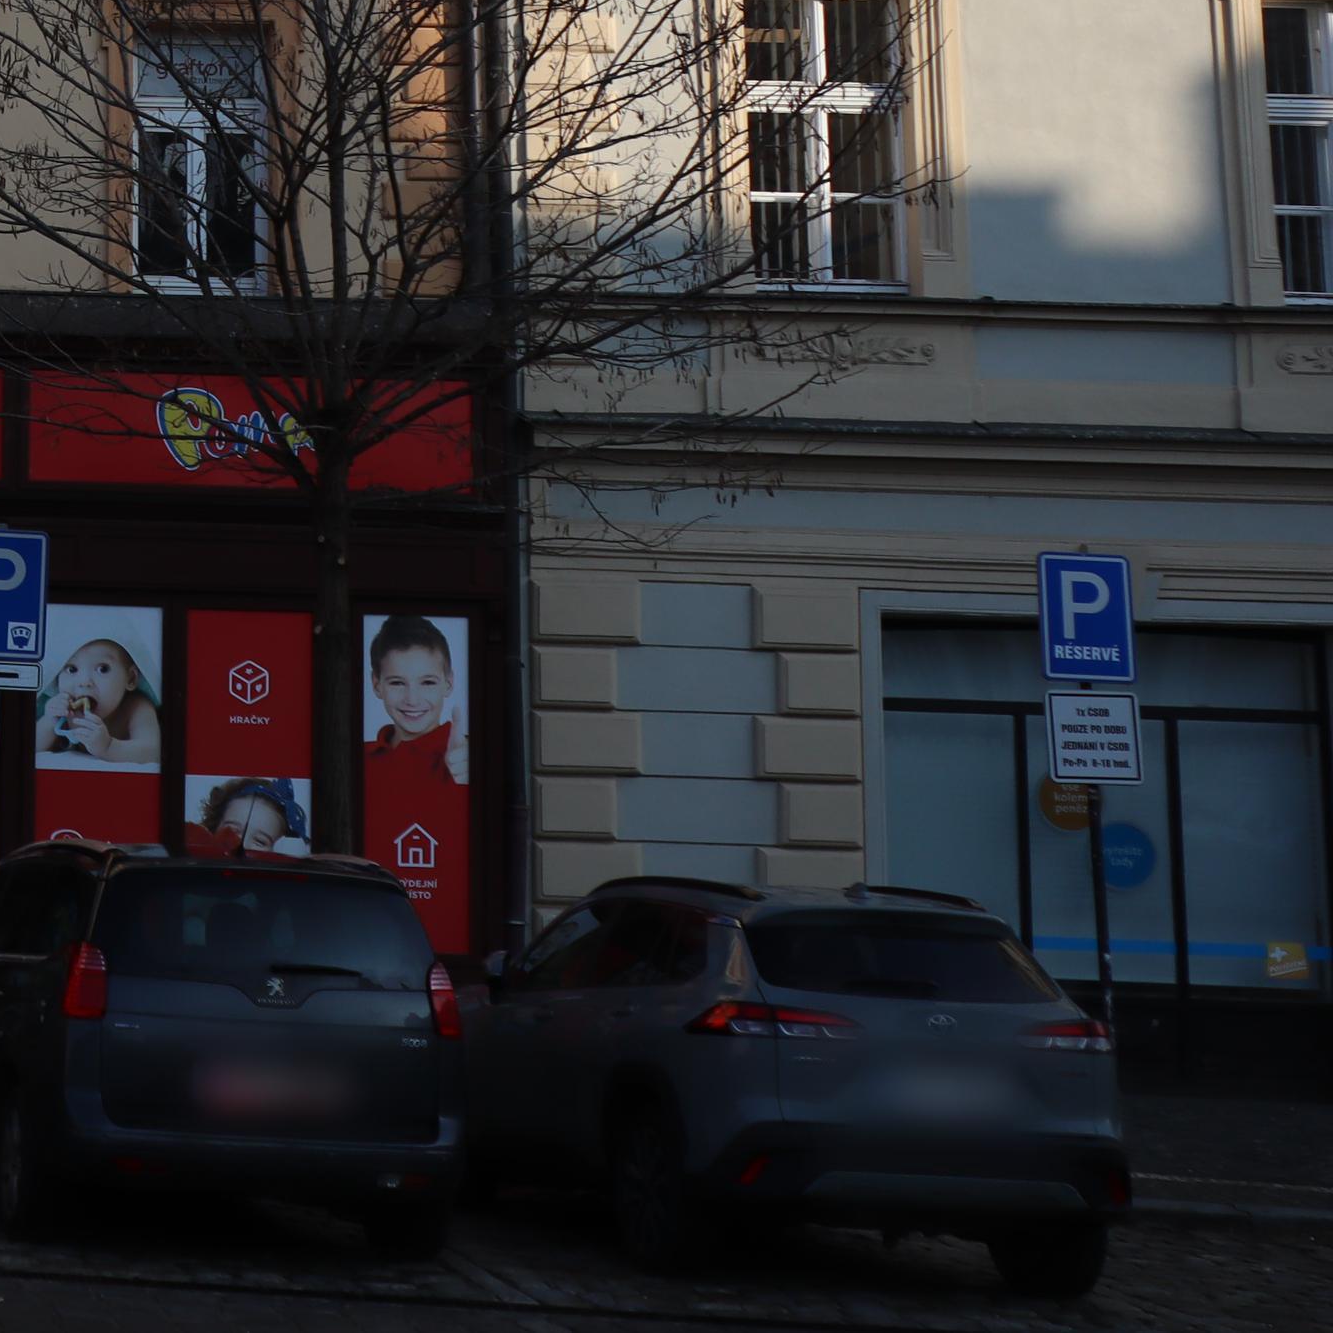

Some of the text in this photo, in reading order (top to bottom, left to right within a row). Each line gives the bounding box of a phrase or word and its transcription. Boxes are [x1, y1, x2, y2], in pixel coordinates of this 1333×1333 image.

[156, 386, 315, 471] Pomp
[1060, 570, 1110, 640] P
[229, 714, 270, 725] HRAČKY
